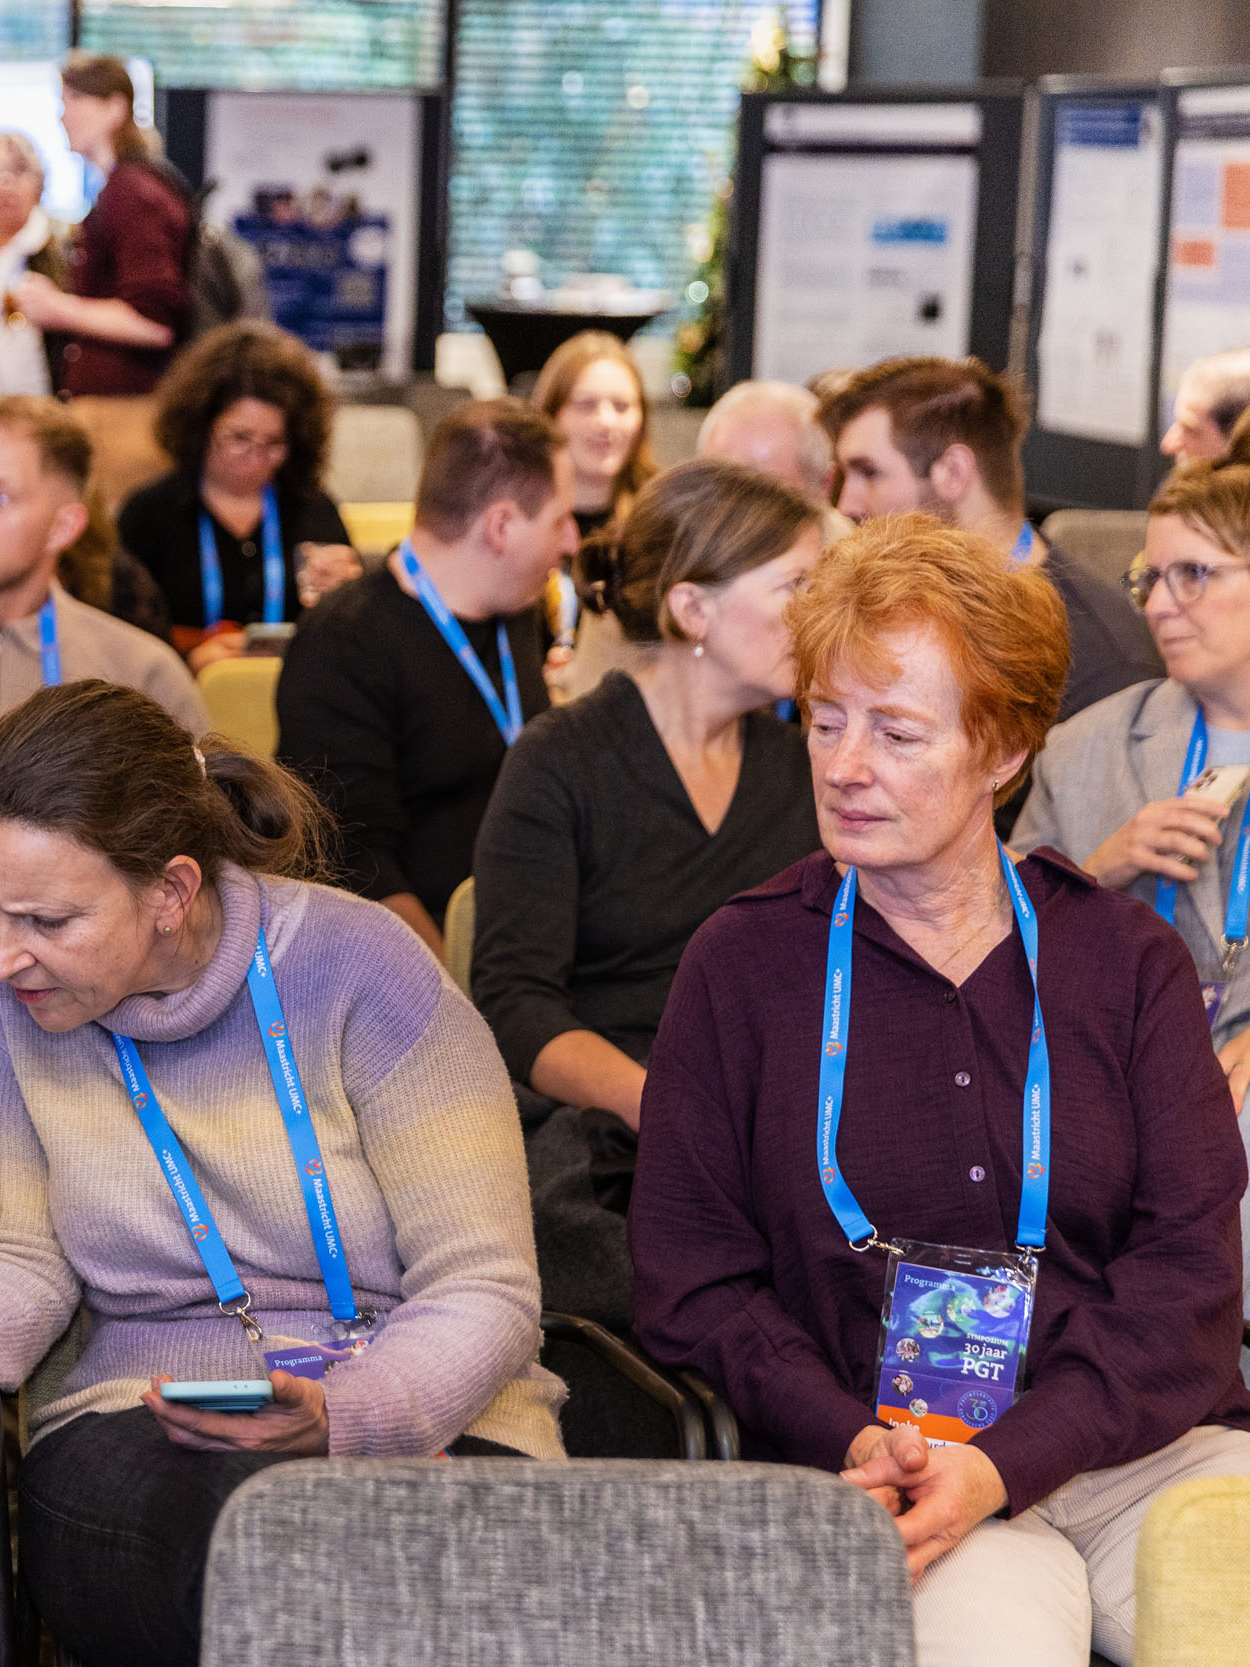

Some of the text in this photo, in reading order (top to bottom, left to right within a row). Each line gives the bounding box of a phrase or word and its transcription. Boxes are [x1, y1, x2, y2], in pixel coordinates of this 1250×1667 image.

[254, 950, 267, 978] UMC+
[830, 967, 843, 1039] Maastricht UMC+
[275, 1039, 303, 1116] Maastricht UMC+
[1031, 1083, 1041, 1160] Maastricht UMC+
[162, 1148, 200, 1223] Maastricht UMC+
[312, 1178, 338, 1259] Maastricht UMC+
[274, 1355, 323, 1367] Programma
[963, 1342, 1007, 1360] 30 jaar
[966, 1332, 1009, 1346] SYMPOSIUM
[960, 1357, 1005, 1381] PGT
